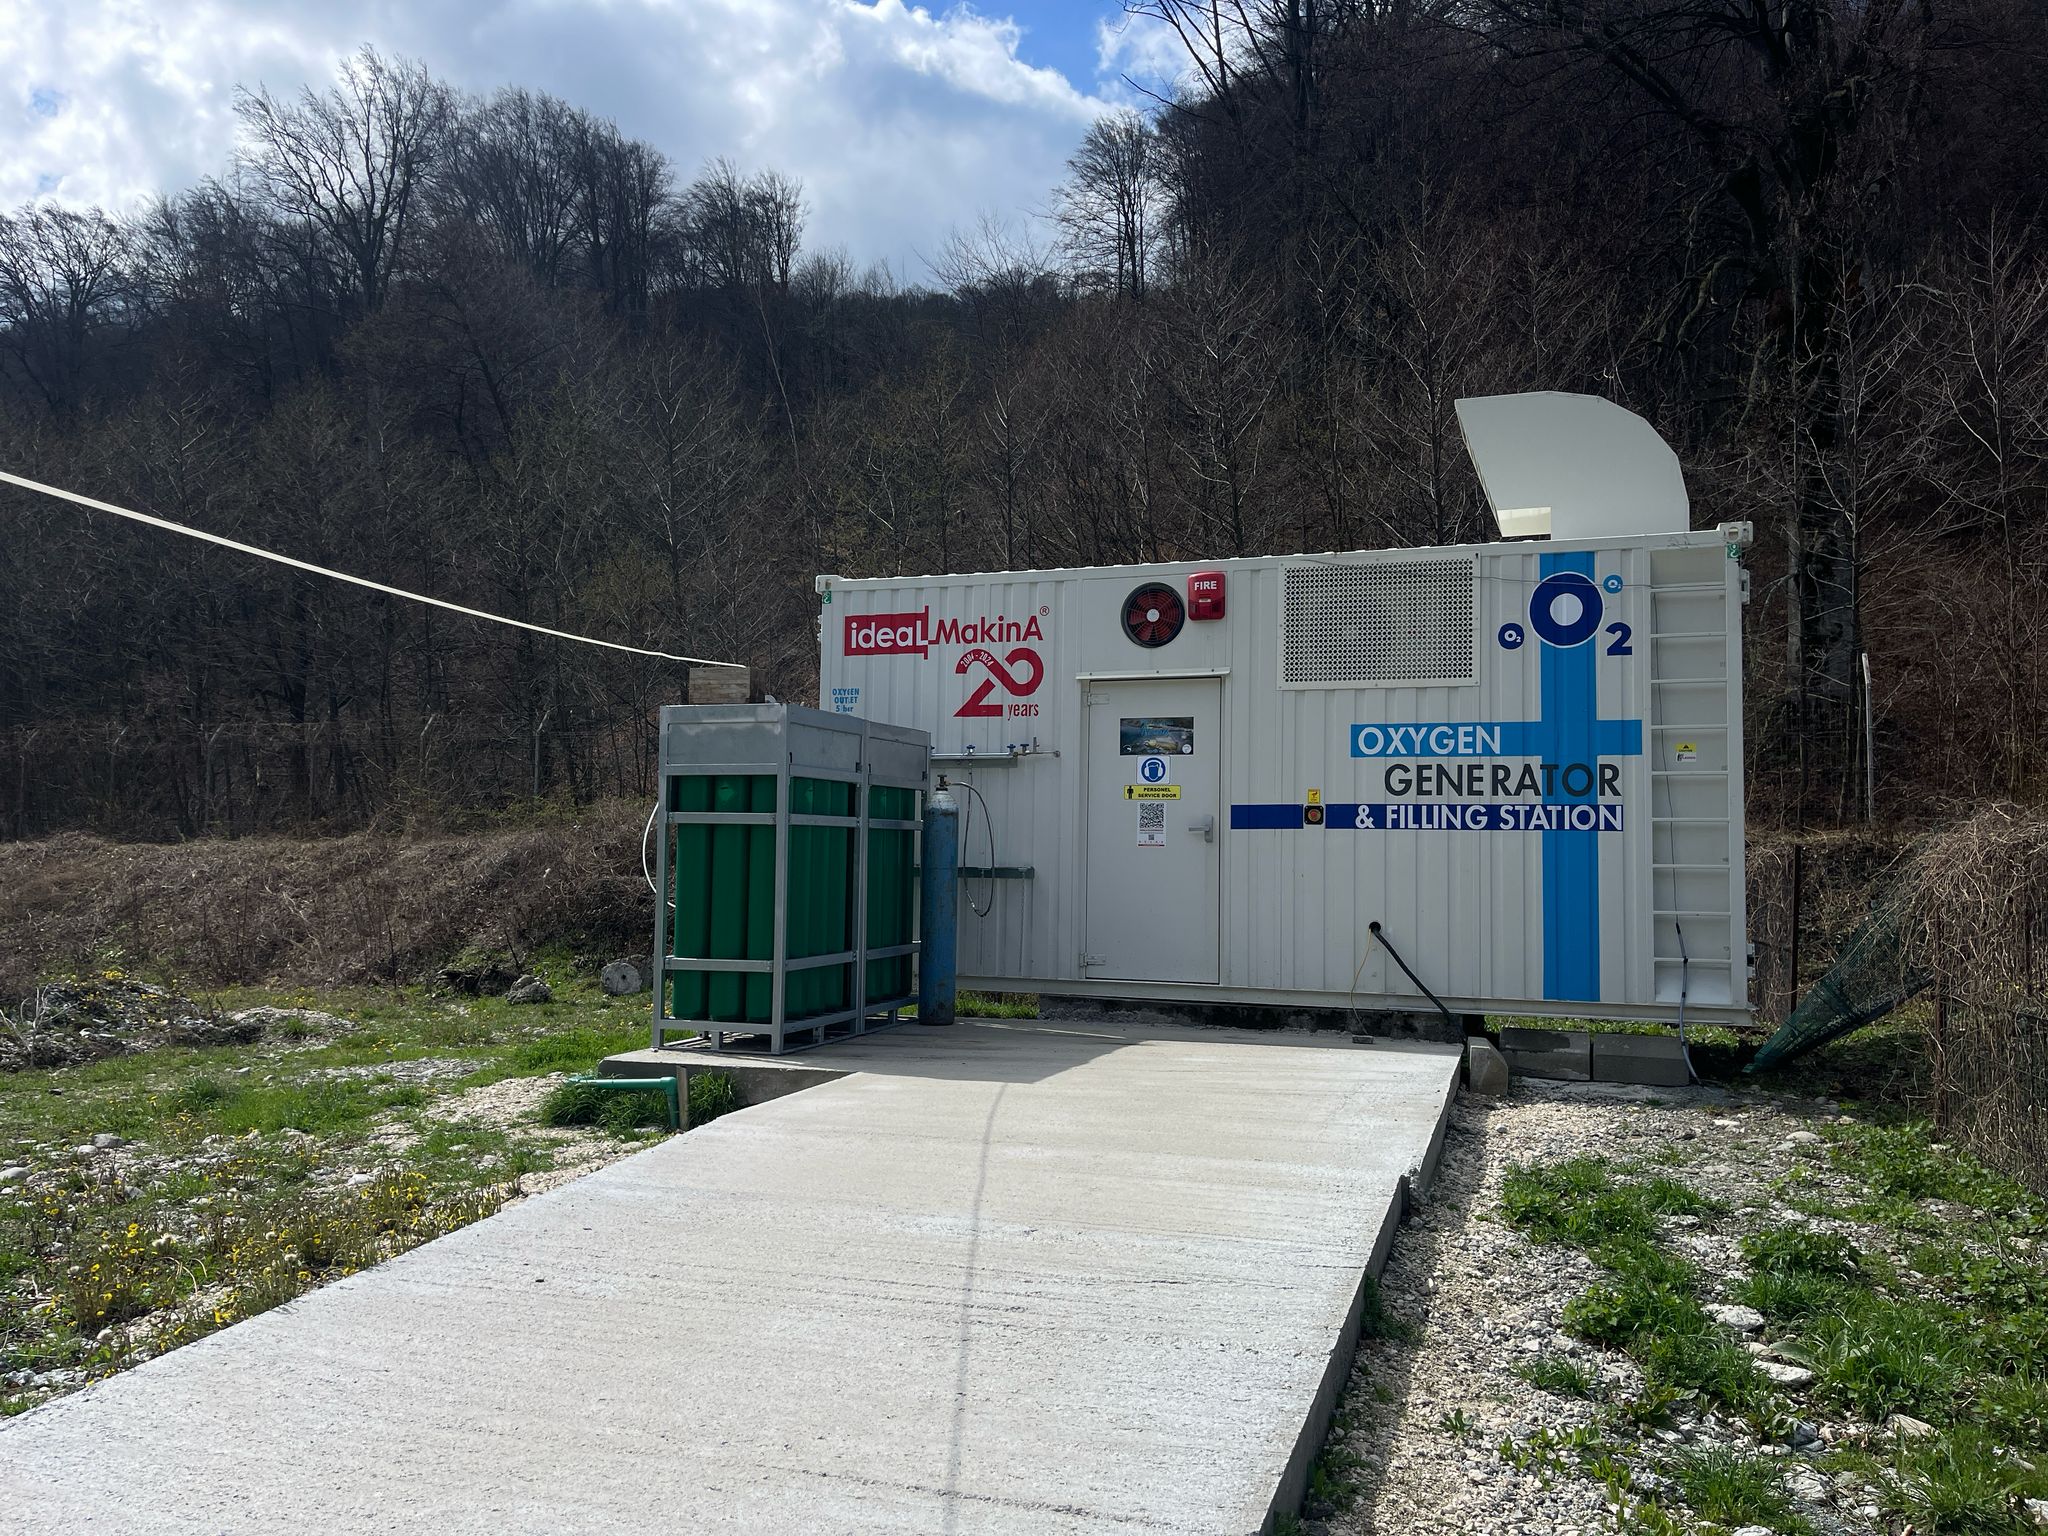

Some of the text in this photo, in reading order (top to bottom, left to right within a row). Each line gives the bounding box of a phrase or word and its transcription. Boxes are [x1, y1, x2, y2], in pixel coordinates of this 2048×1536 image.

[1194, 580, 1217, 591] FIRE
[979, 651, 994, 667] 2024
[832, 688, 860, 696] OXYGEN
[1007, 702, 1039, 721] years
[1357, 725, 1501, 755] OXYGEN
[1384, 762, 1622, 798] GENERATOR
[1354, 804, 1623, 831] & FILLING STATION
